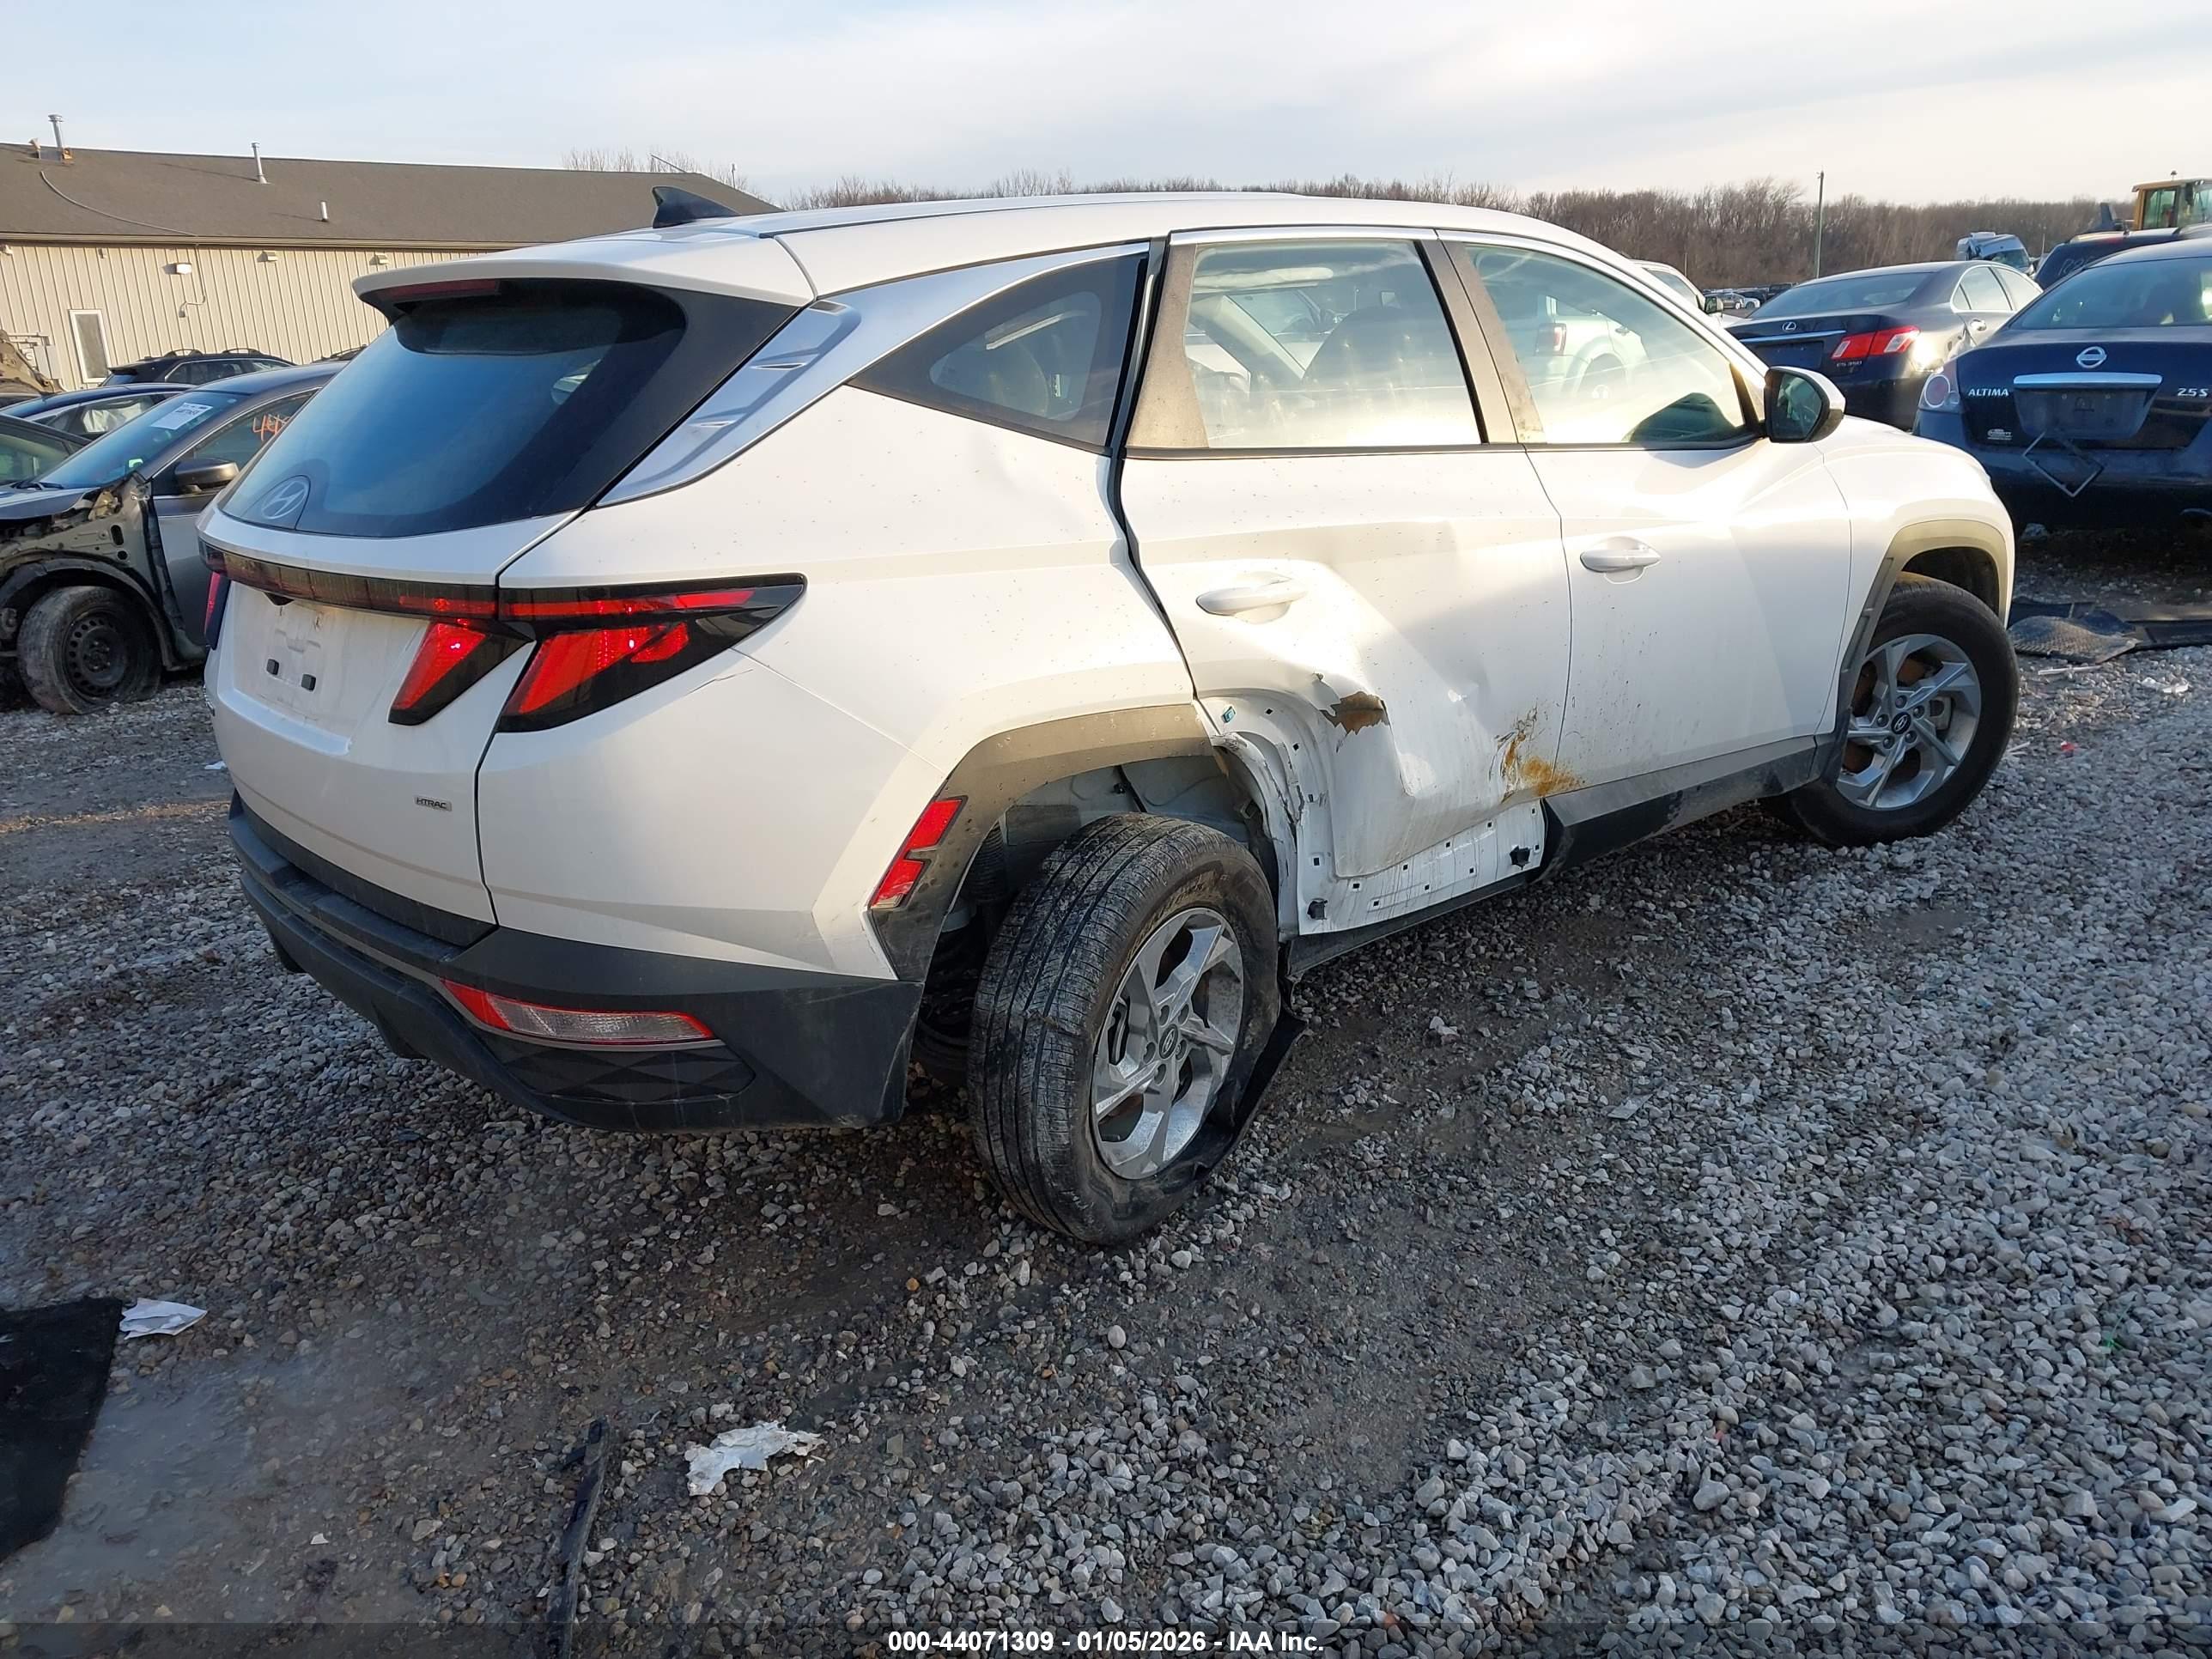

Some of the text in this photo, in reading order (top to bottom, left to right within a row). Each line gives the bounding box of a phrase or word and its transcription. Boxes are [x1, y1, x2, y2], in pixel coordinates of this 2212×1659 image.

[1968, 388, 2009, 397] ALTIMA
[2198, 388, 2209, 397] S
[416, 797, 447, 810] HTRAC
